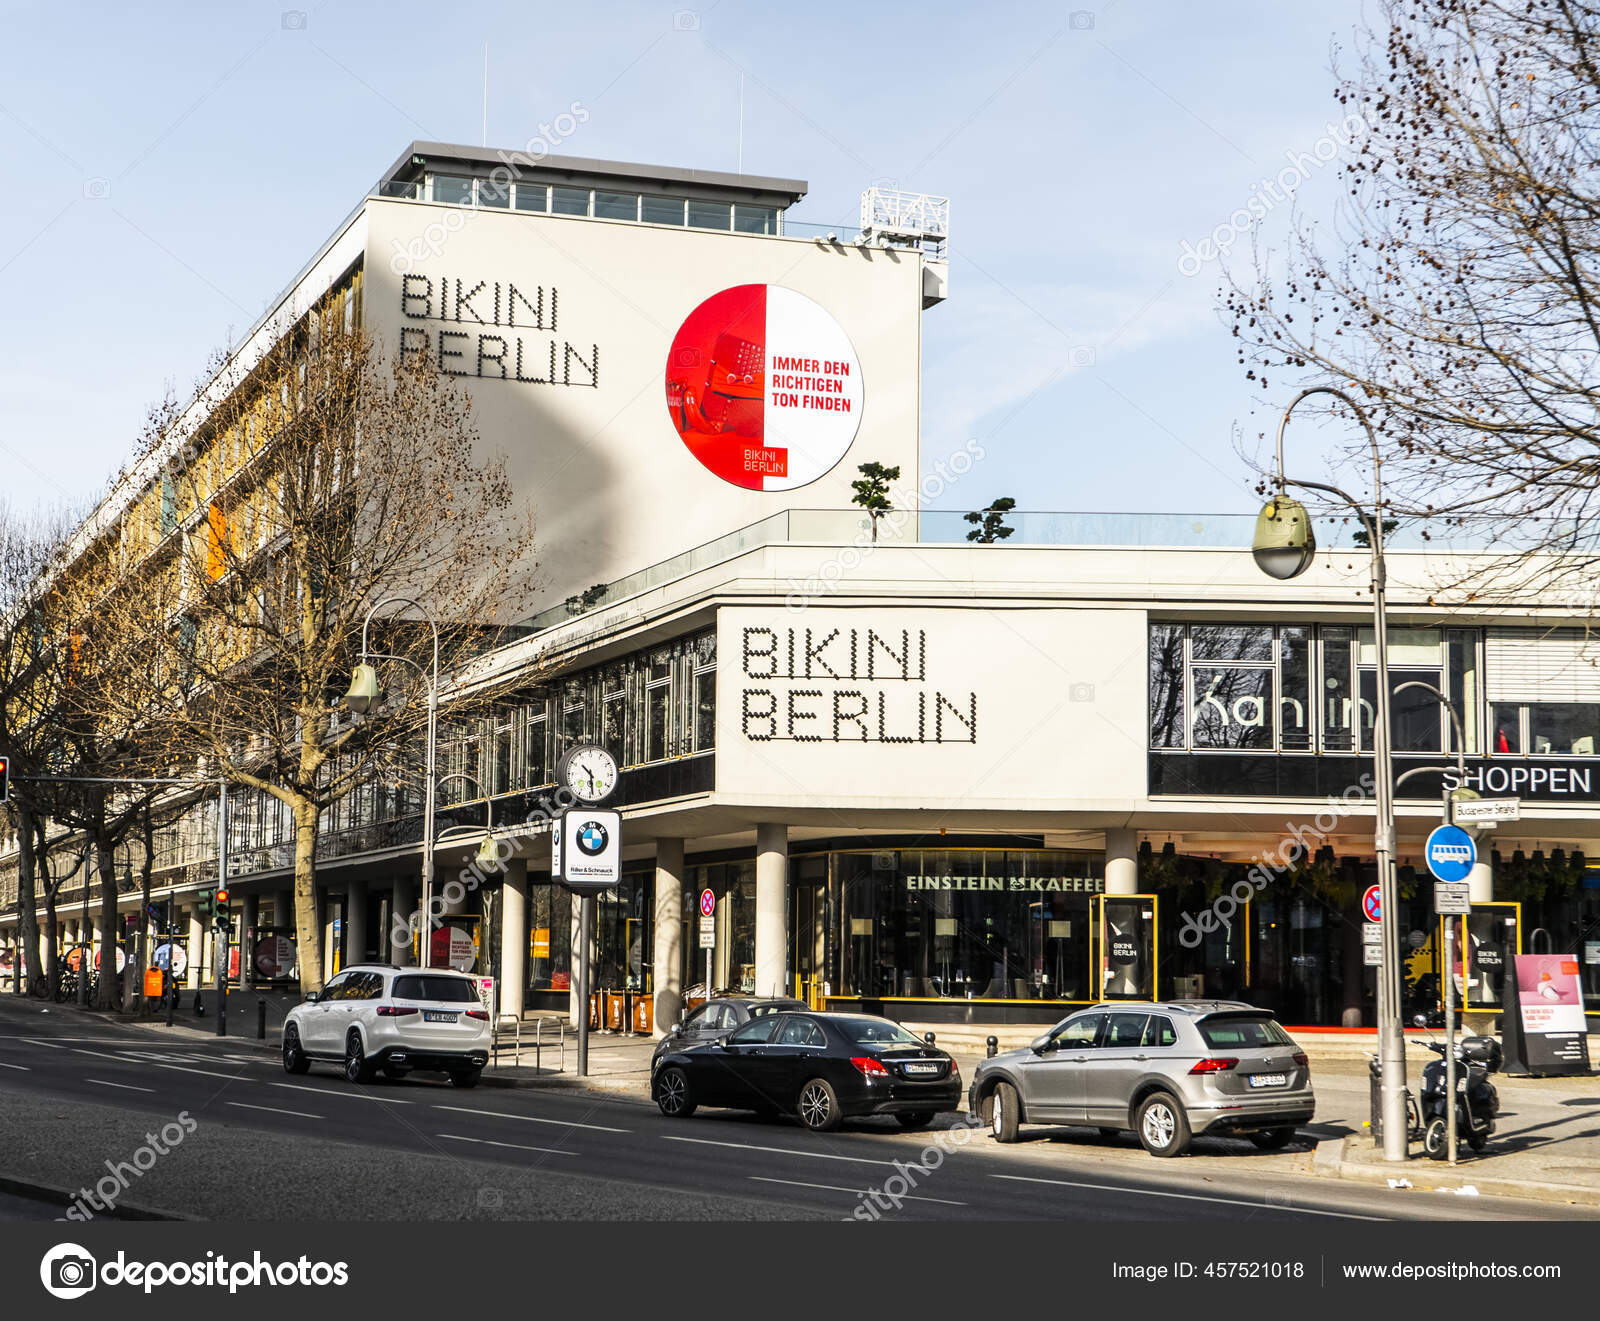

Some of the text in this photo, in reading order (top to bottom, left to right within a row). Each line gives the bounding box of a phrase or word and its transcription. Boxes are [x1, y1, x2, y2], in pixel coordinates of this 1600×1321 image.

[402, 274, 557, 332] BIKINI
[401, 327, 598, 388] BERLIN
[773, 356, 850, 376] IMMER DEN
[773, 374, 842, 393] RICHTIGEN
[772, 393, 851, 412] TON FINDEN
[744, 449, 776, 461] BIKINI
[744, 460, 784, 473] BERLIN
[743, 627, 925, 681] BIKINI
[742, 689, 977, 744] BERLIN
[1442, 766, 1591, 792] SHOPPEN
[906, 876, 1105, 892] EINSTEIN KAFFEE
